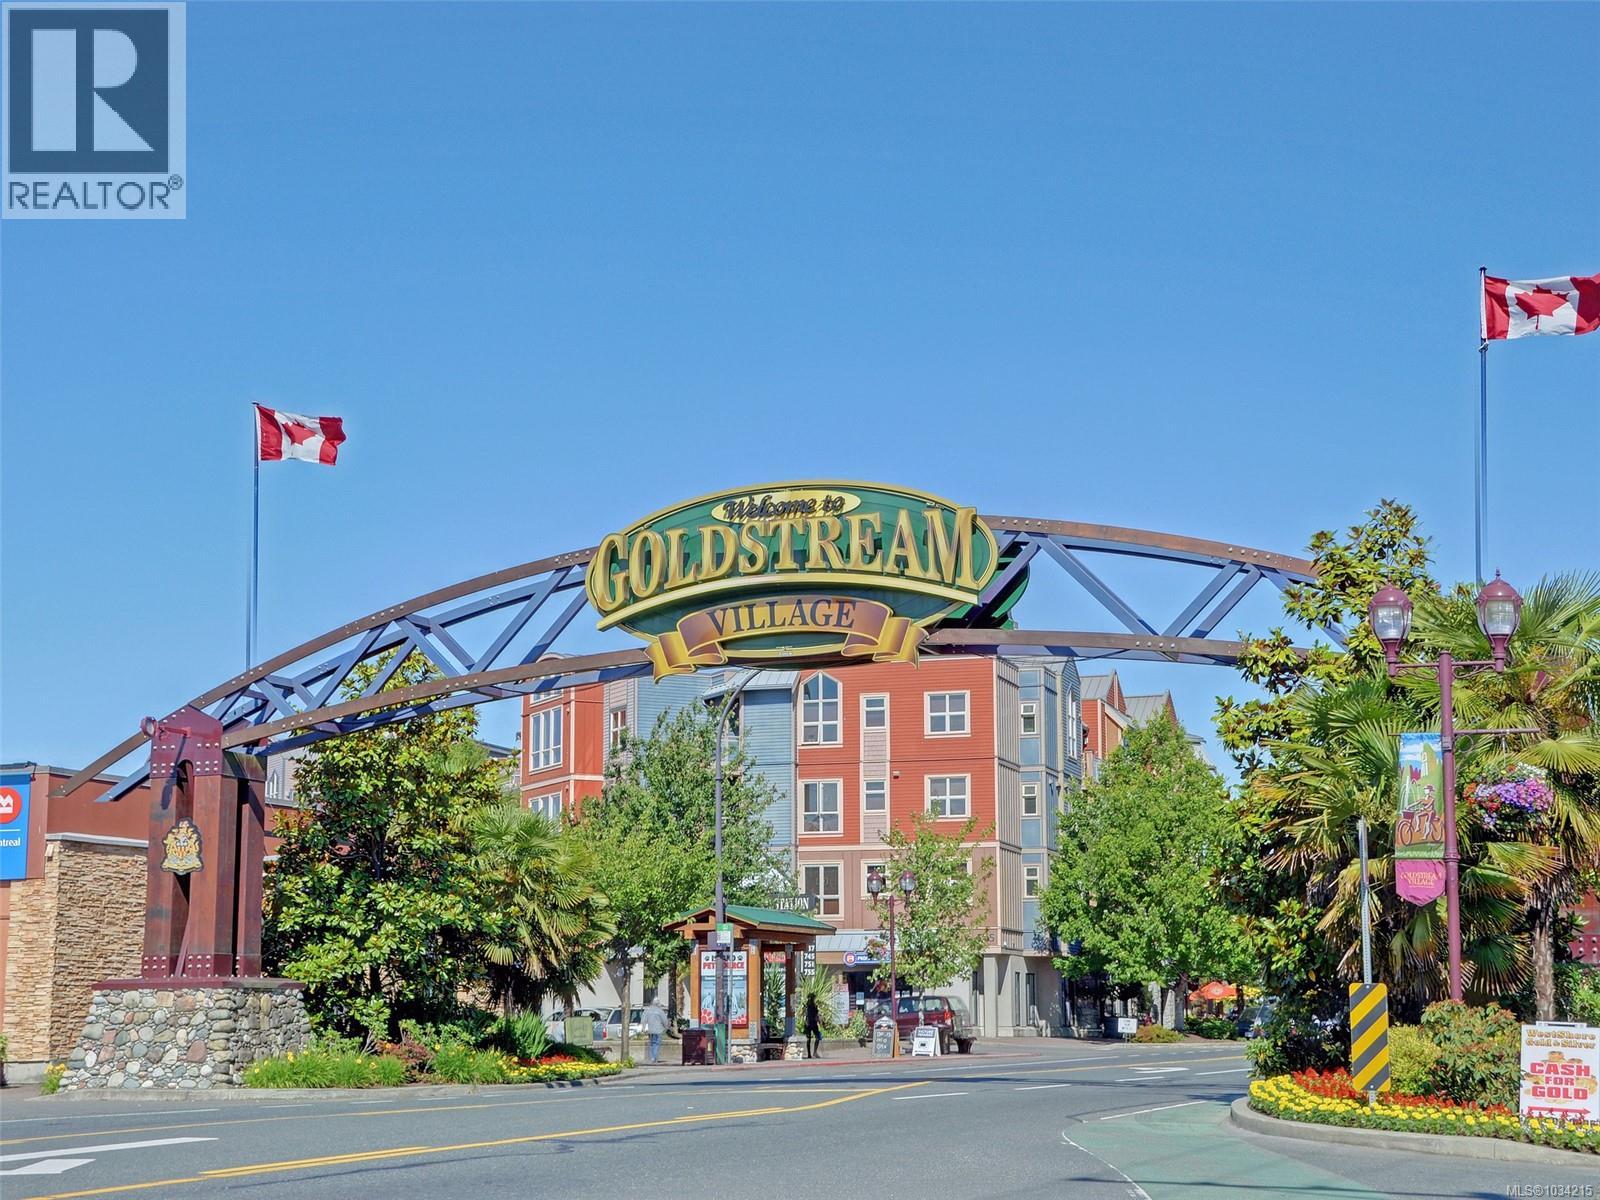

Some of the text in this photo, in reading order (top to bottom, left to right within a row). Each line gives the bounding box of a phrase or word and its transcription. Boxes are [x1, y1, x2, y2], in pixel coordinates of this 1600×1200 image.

[723, 494, 846, 520] Welcome to
[597, 506, 978, 611] GOLDSTREAM
[706, 599, 857, 636] VILLAGE
[1530, 1062, 1590, 1077] CASH
[1545, 1076, 1575, 1086] FOR
[1531, 1086, 1589, 1100] GOLD
